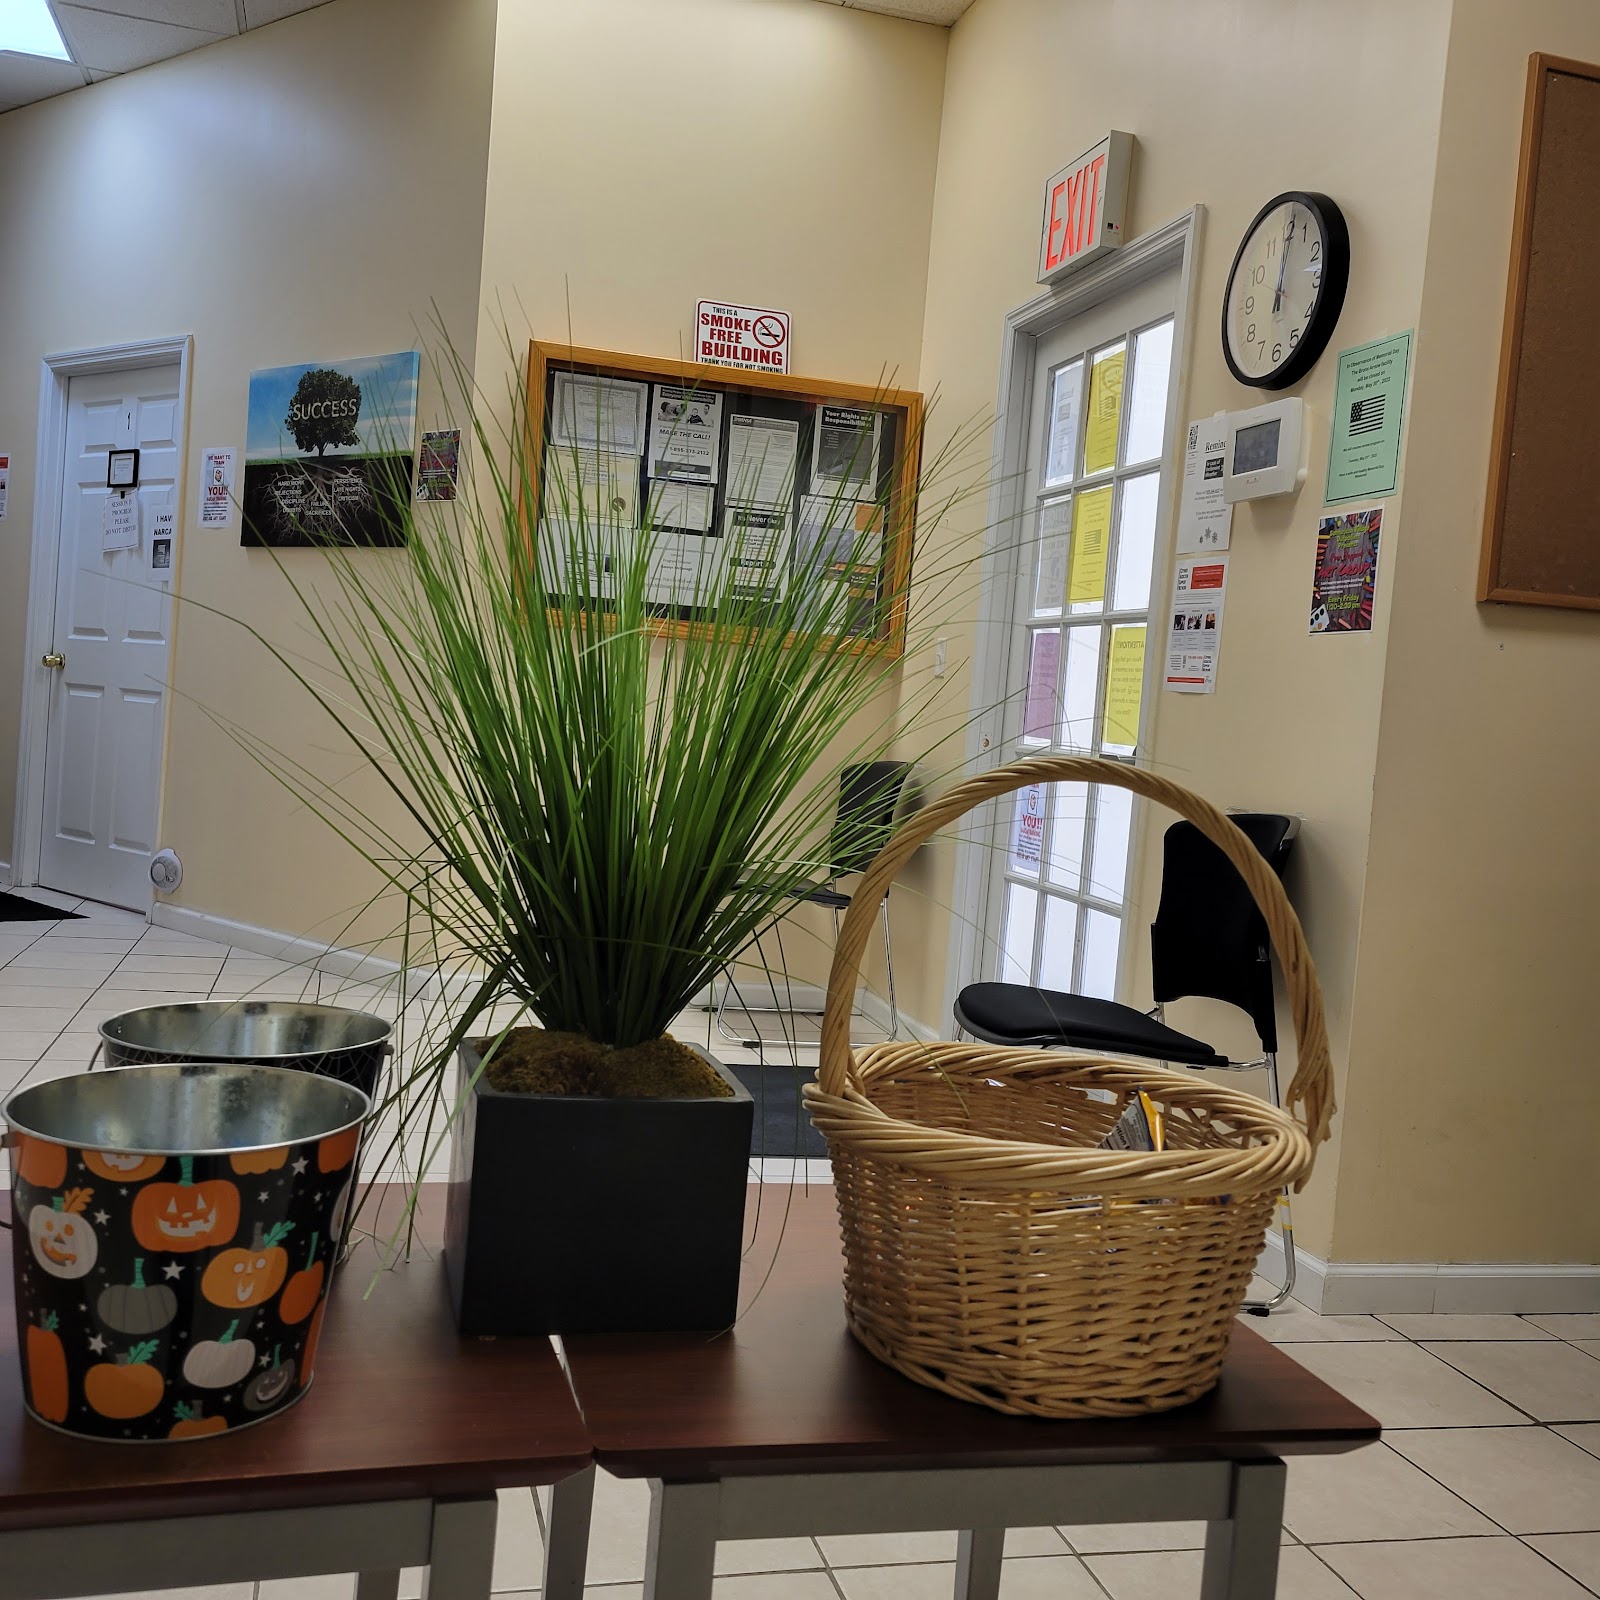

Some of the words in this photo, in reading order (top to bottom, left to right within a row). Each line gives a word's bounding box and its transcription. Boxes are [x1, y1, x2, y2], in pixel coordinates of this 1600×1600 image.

[1046, 153, 1105, 271] EXIT
[1282, 220, 1295, 242] 12
[1302, 223, 1308, 243] 1
[1266, 237, 1277, 259] 11
[1310, 241, 1320, 262] 2
[1251, 265, 1265, 287] 10
[1312, 268, 1321, 289] 3
[712, 306, 726, 315] THIS
[726, 308, 733, 316] IS
[1245, 296, 1255, 315] 9
[1304, 301, 1314, 319] 4
[701, 312, 751, 332] SMOKE
[709, 327, 742, 344] FREE
[1246, 324, 1256, 342] 8
[1289, 328, 1300, 349] 5
[701, 340, 783, 366] BUILDING
[1257, 340, 1266, 360] 7
[1272, 343, 1282, 362] 6
[701, 357, 720, 365] THANK
[733, 361, 744, 369] FOR
[744, 363, 756, 371] NOT
[757, 365, 783, 374] SMOKING
[292, 398, 357, 421] SUCCESS
[841, 412, 860, 420] Rights
[1343, 594, 1359, 602] Friday
[1023, 815, 1043, 830] YOU!!
